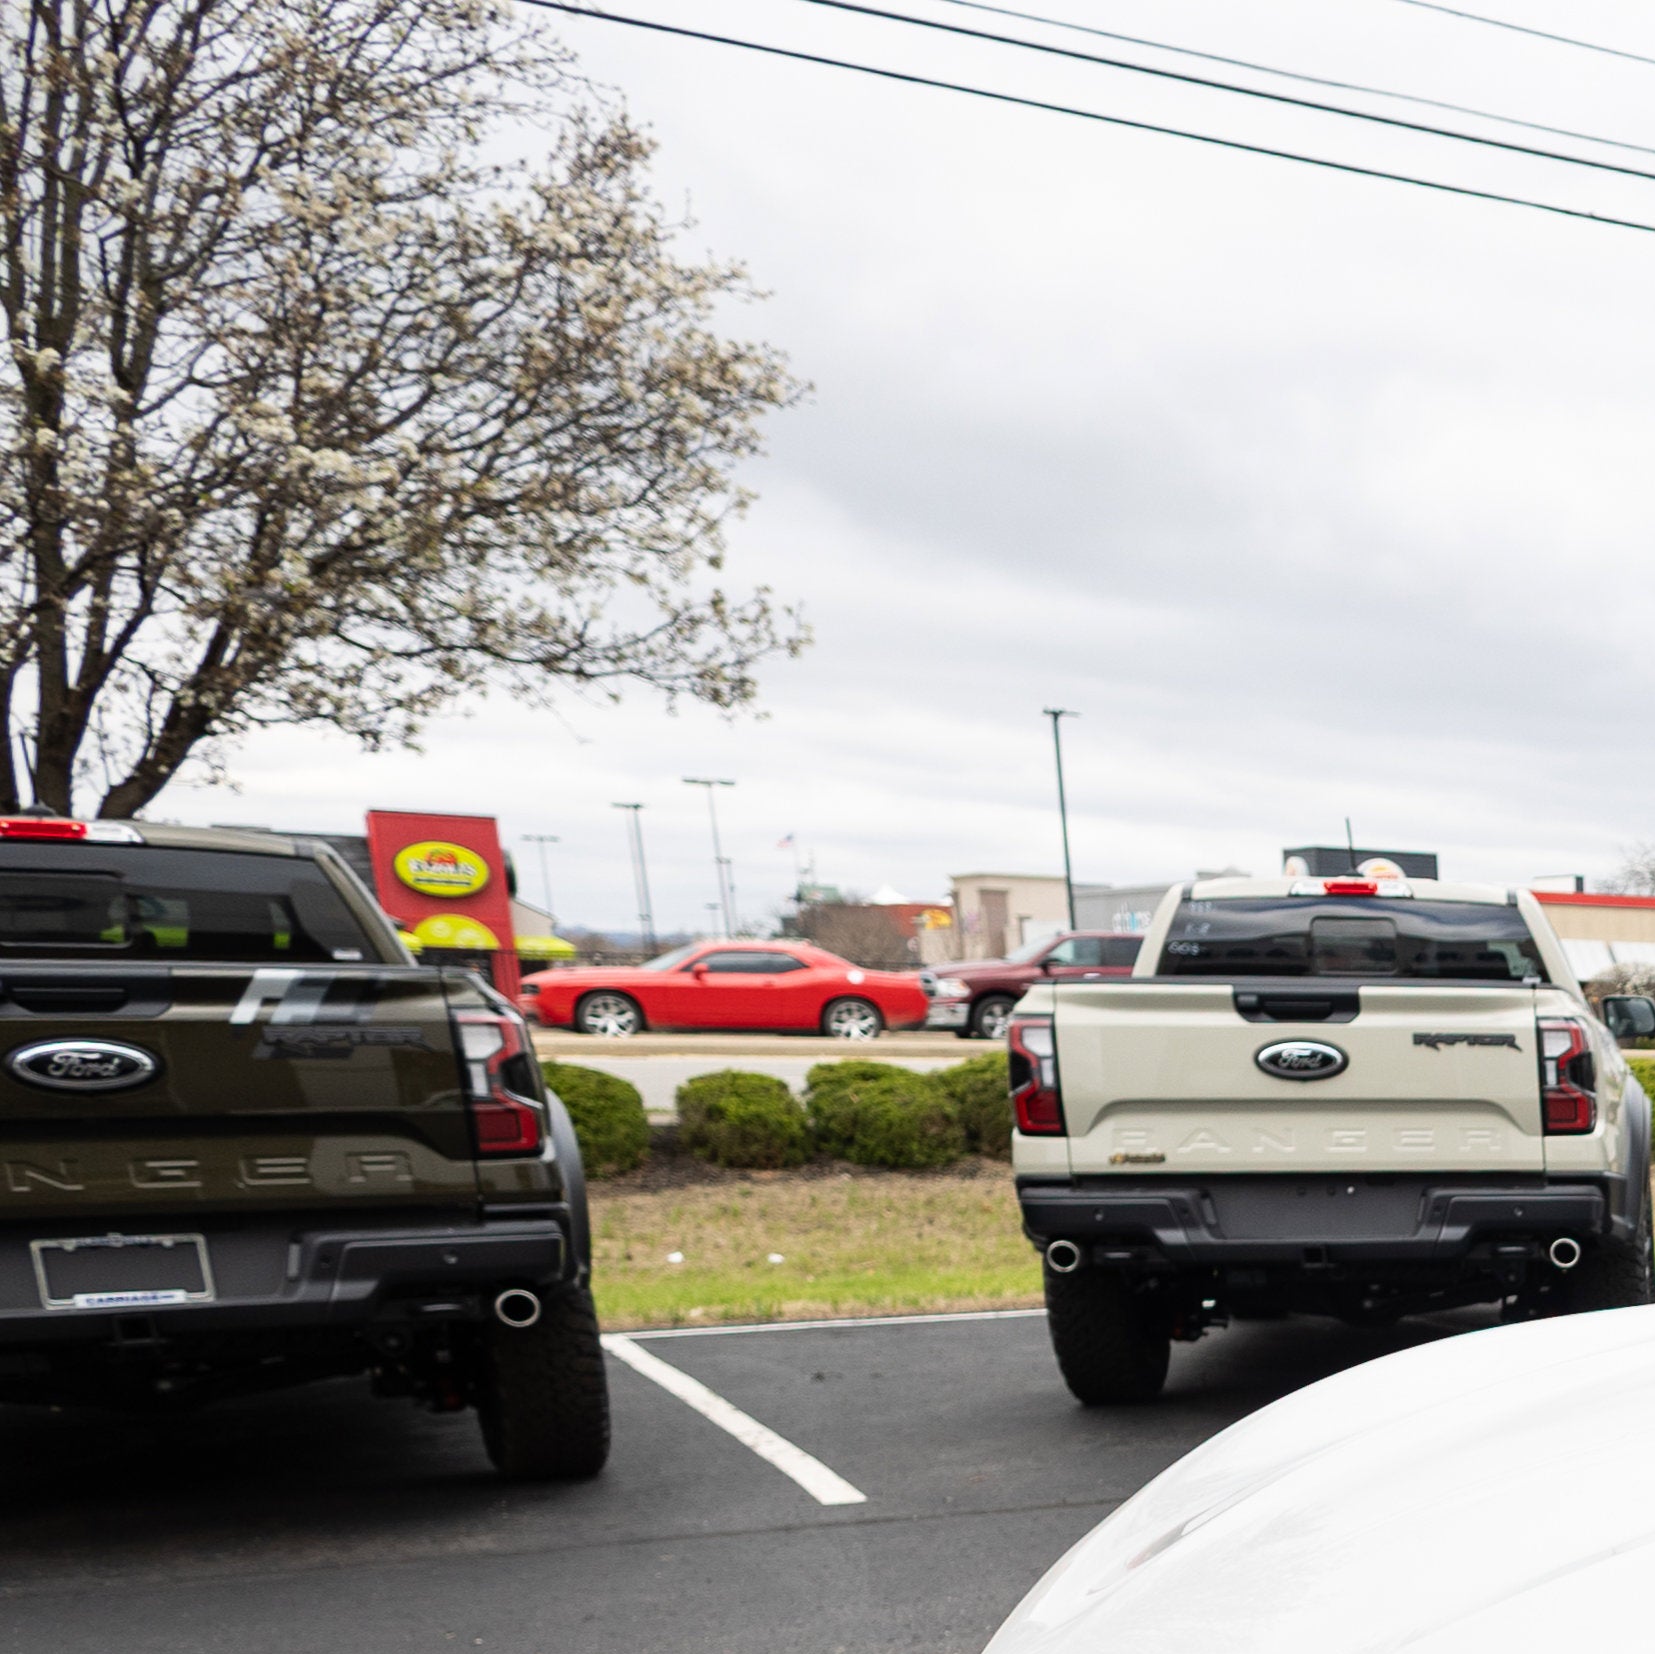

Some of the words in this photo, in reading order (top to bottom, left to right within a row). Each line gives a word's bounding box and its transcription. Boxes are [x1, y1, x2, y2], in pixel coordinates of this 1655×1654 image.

[48, 1051, 121, 1077] Ford
[1278, 1048, 1323, 1070] Ford
[1111, 1126, 1502, 1154] RANGER
